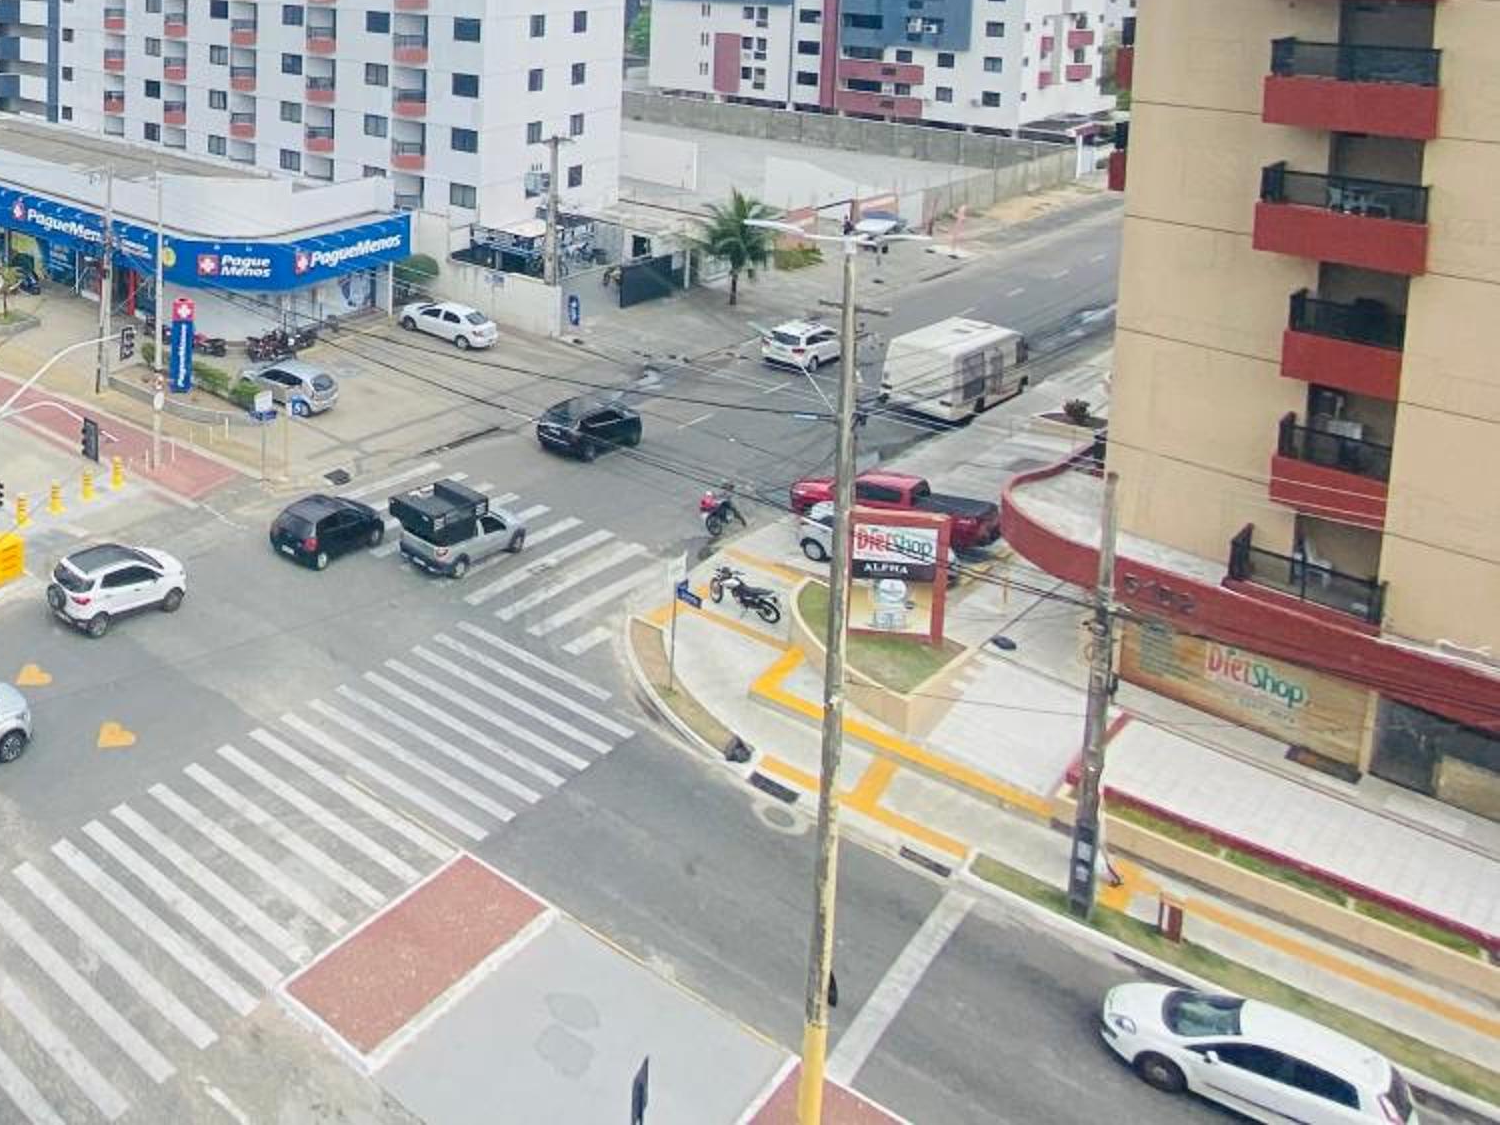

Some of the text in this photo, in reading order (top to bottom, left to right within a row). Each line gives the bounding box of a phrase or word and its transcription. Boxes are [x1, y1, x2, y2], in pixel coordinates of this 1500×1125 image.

[27, 208, 117, 247] PagueMen
[221, 254, 271, 270] Pague
[309, 234, 402, 268] PagueMenos
[221, 266, 271, 277] Menos
[863, 562, 908, 574] ALPHA
[1207, 646, 1304, 709] DietShop
